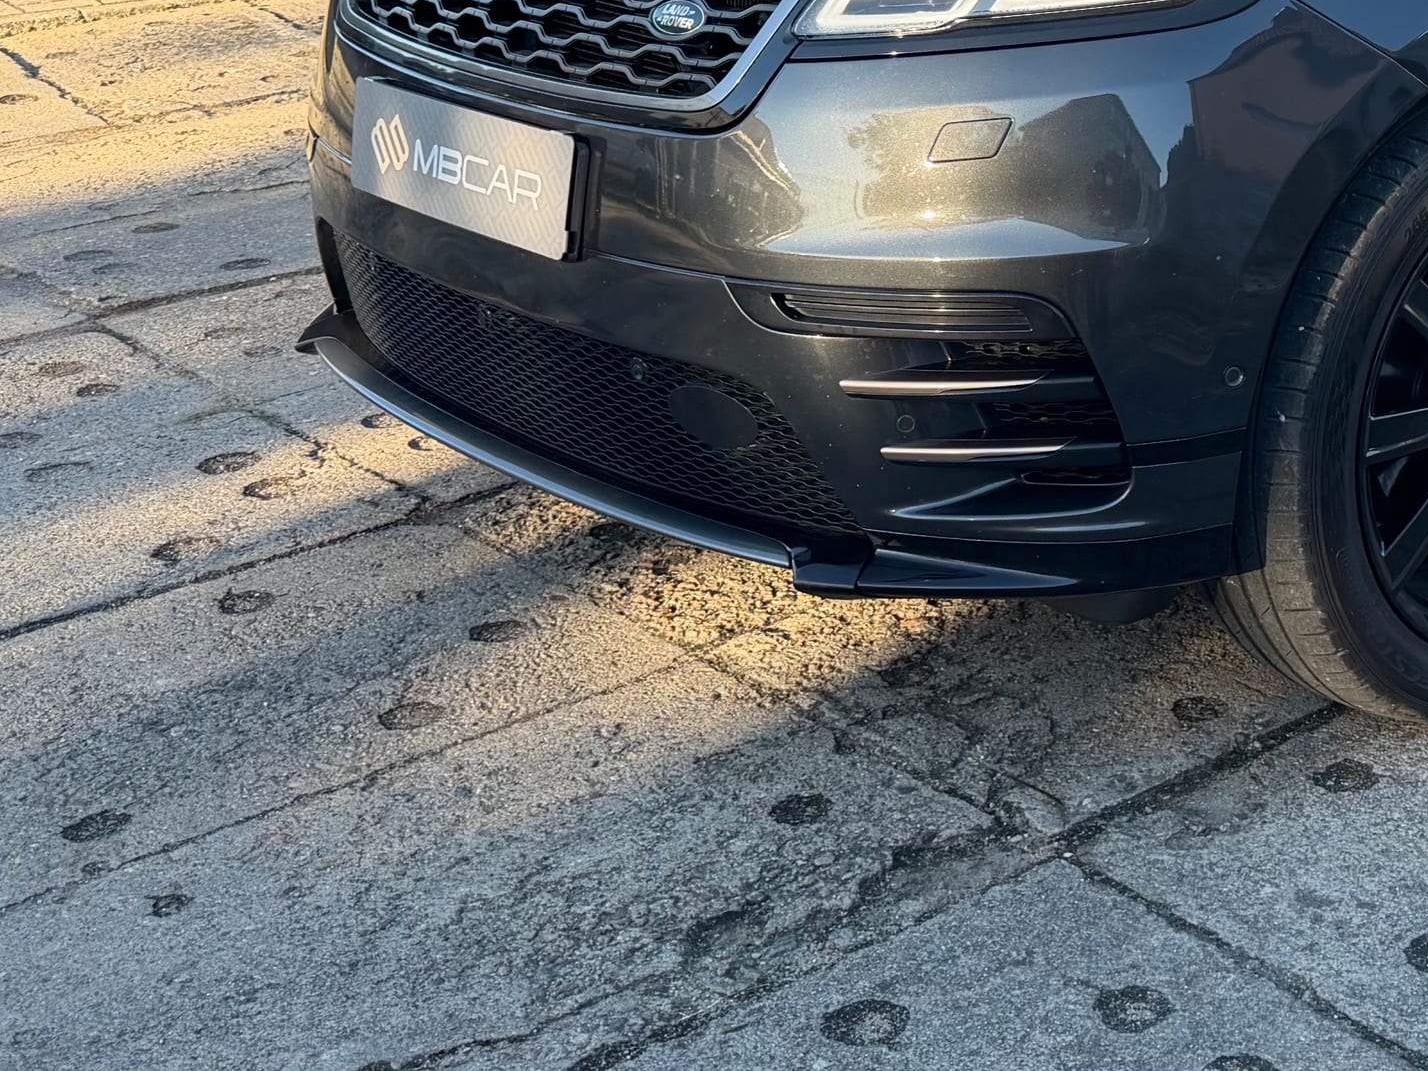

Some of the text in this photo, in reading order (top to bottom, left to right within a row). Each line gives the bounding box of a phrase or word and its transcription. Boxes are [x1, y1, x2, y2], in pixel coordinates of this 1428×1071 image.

[662, 3, 690, 16] LAND
[660, 14, 695, 29] ROVER
[413, 138, 542, 211] MBCAR
